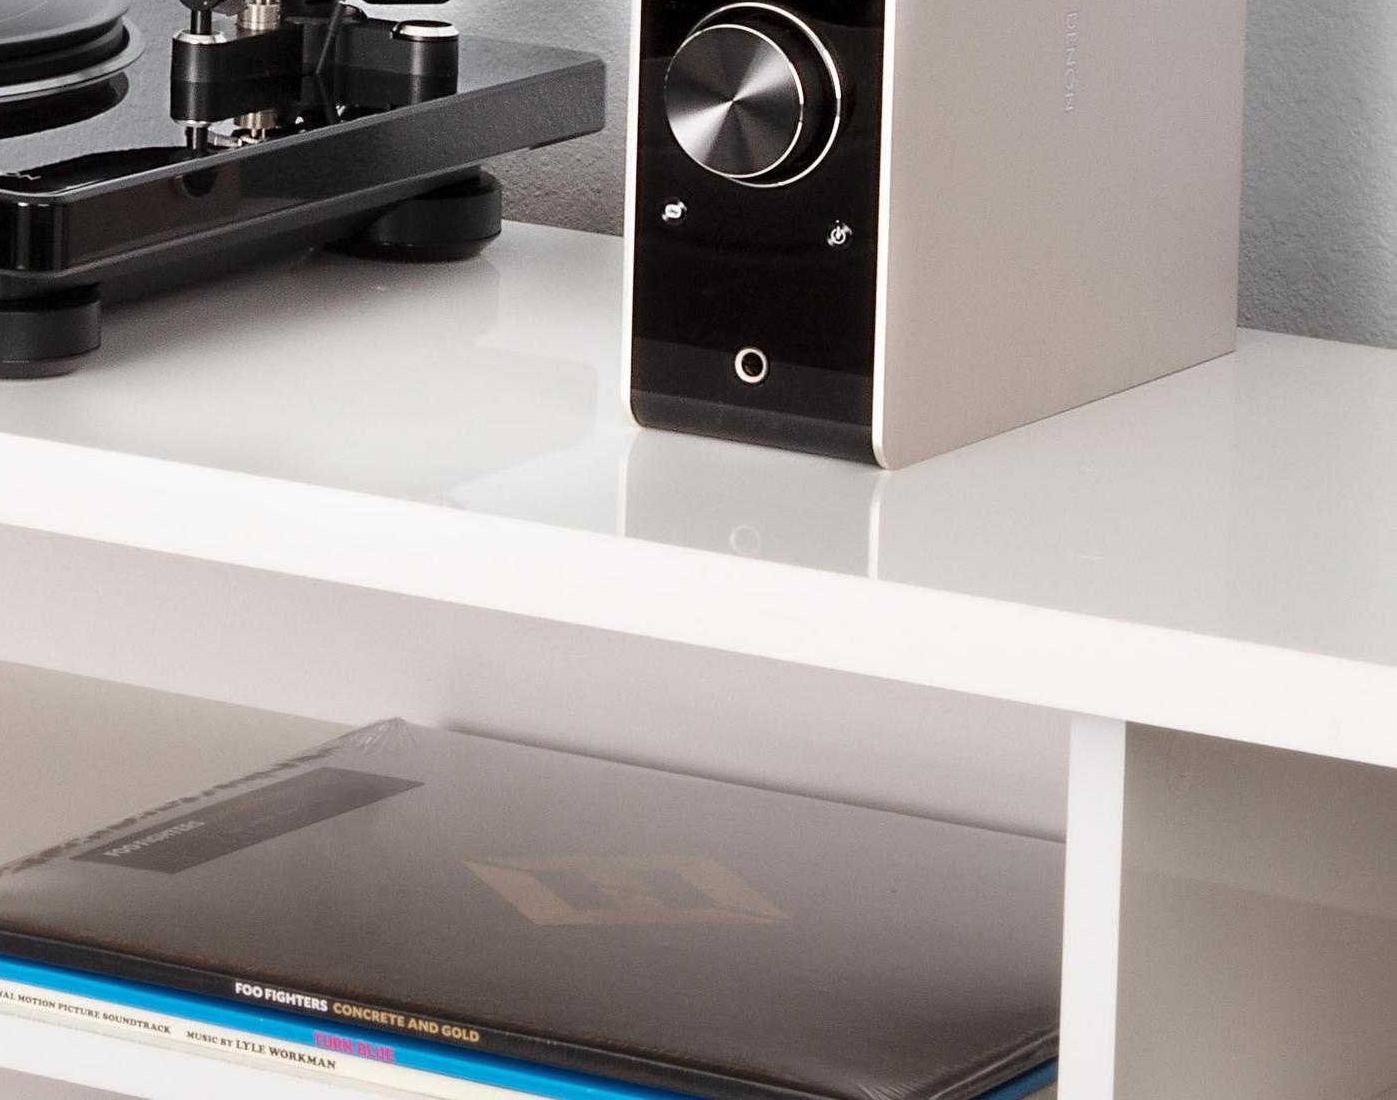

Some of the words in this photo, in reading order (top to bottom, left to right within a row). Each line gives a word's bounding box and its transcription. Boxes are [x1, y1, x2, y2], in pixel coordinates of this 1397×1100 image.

[1063, 11, 1078, 113] DENON
[18, 994, 56, 1009] MOTION
[58, 1003, 100, 1019] PICTURE
[103, 1013, 172, 1034] SOUNDTRACK
[187, 1031, 218, 1044] MUSIC
[220, 1038, 234, 1048] BY
[236, 1040, 266, 1055] LYLE
[269, 1047, 336, 1070] WORKMAN
[235, 982, 263, 998] FOO
[265, 988, 328, 1012] FIGHTERS
[333, 1002, 405, 1027] CONCRETE
[408, 1018, 439, 1034] AND
[441, 1025, 480, 1042] GOLD
[313, 1030, 353, 1053] TURN
[357, 1039, 395, 1062] BLUE
